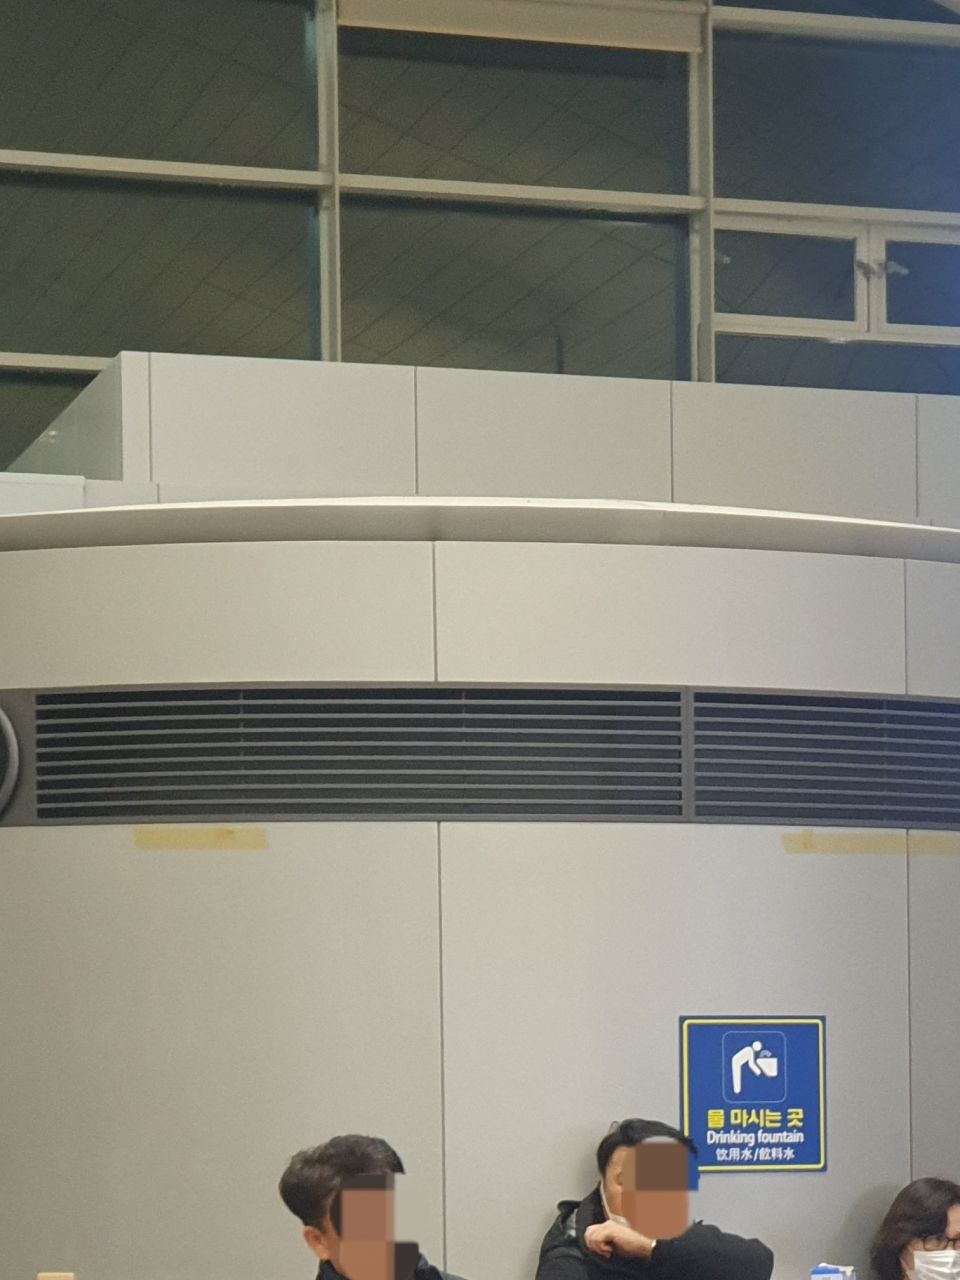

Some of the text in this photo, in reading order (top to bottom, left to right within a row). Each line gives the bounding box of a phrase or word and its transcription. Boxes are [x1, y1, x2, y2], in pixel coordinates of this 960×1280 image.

[708, 1108, 804, 1128] 물 마시는 곳
[707, 1129, 804, 1146] Drinking fountain
